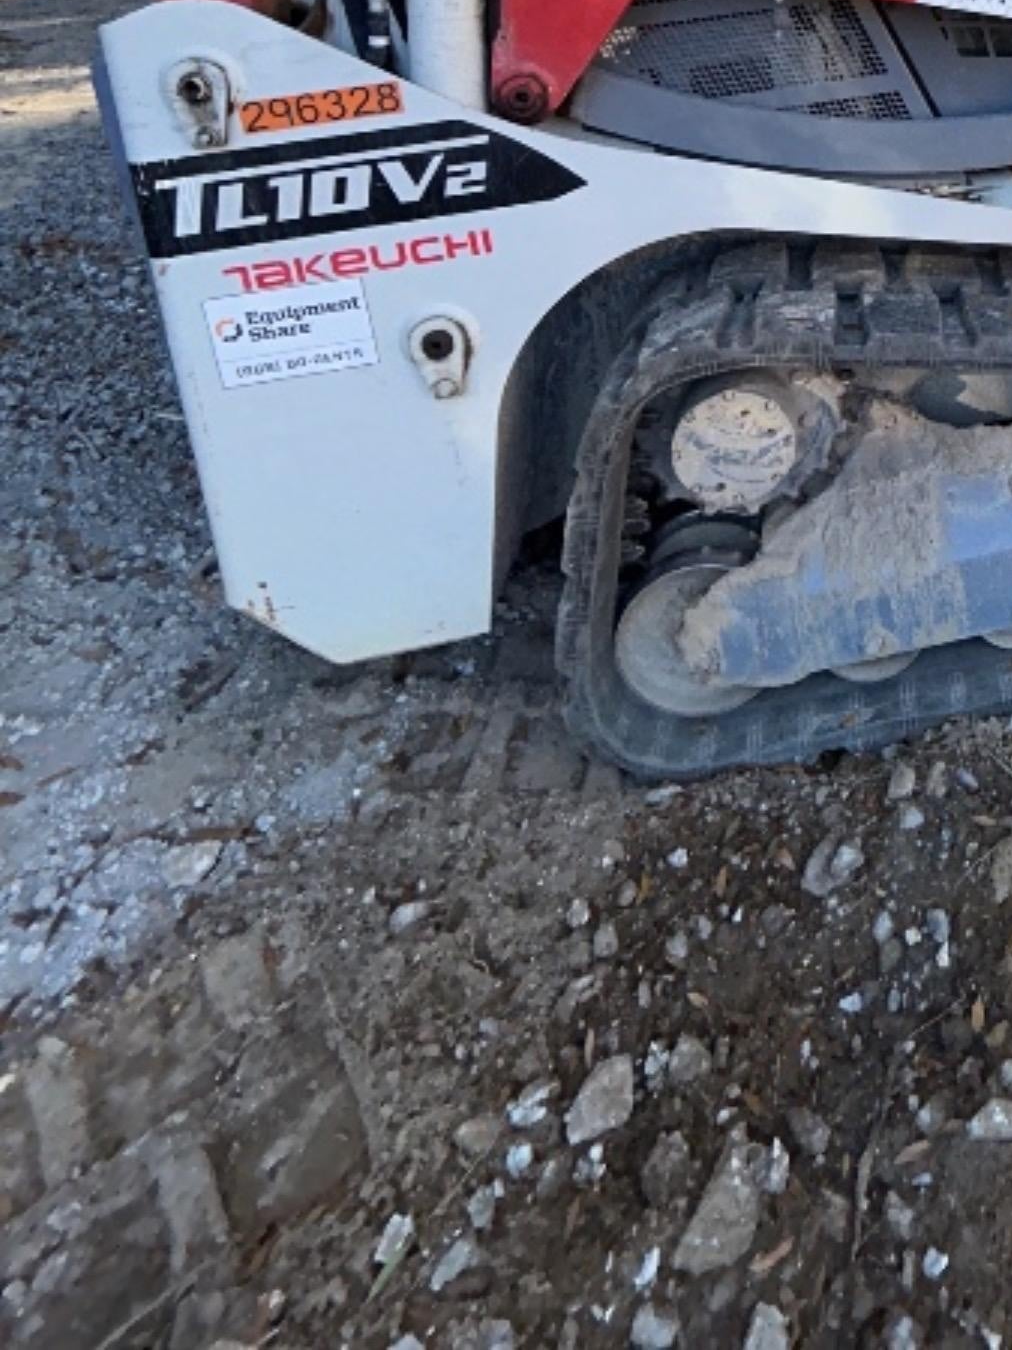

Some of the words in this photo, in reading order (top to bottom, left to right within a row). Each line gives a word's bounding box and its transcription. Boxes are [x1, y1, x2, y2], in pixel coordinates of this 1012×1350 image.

[242, 83, 400, 133] 296328
[155, 136, 490, 238] TL10V2
[244, 296, 361, 325] Equipment
[247, 322, 312, 343] Share
